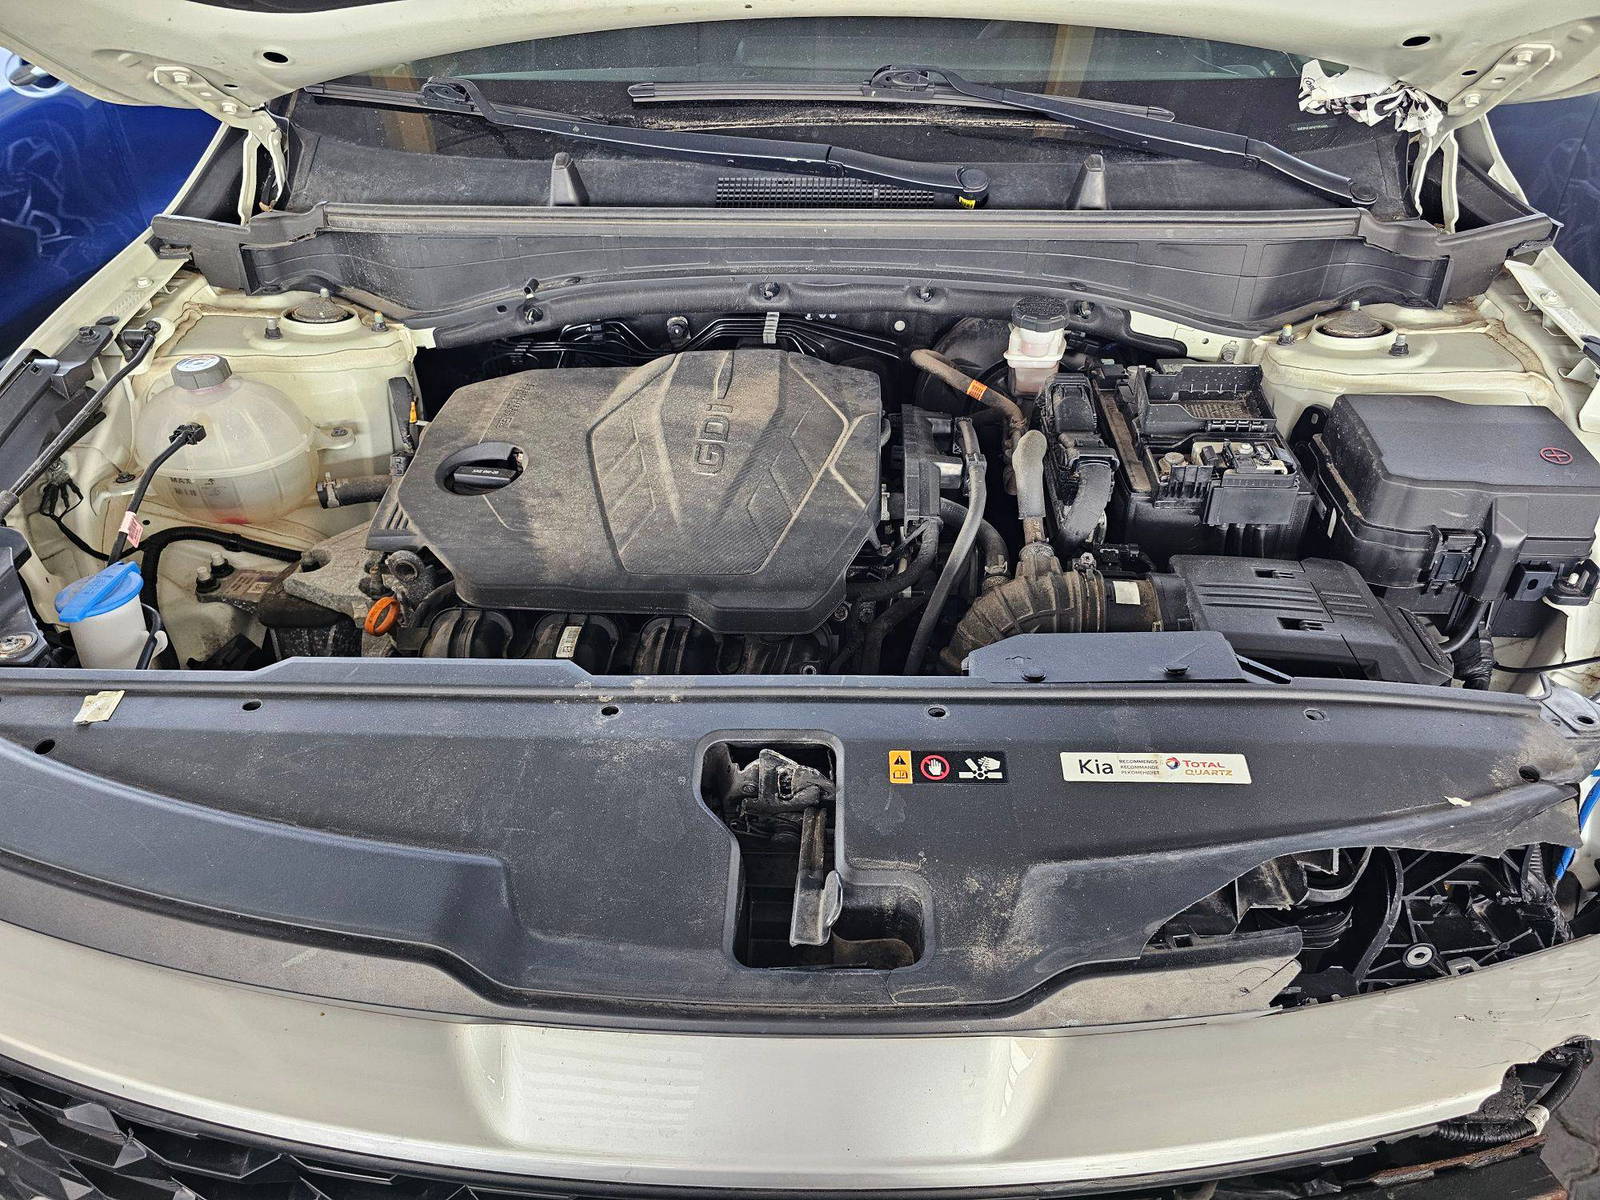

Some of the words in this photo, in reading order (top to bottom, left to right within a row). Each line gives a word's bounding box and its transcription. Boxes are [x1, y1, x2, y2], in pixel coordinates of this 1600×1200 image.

[1078, 759, 1114, 775] Kia
[1181, 759, 1226, 769] TOTAL
[1184, 769, 1233, 777] QUARTZ
